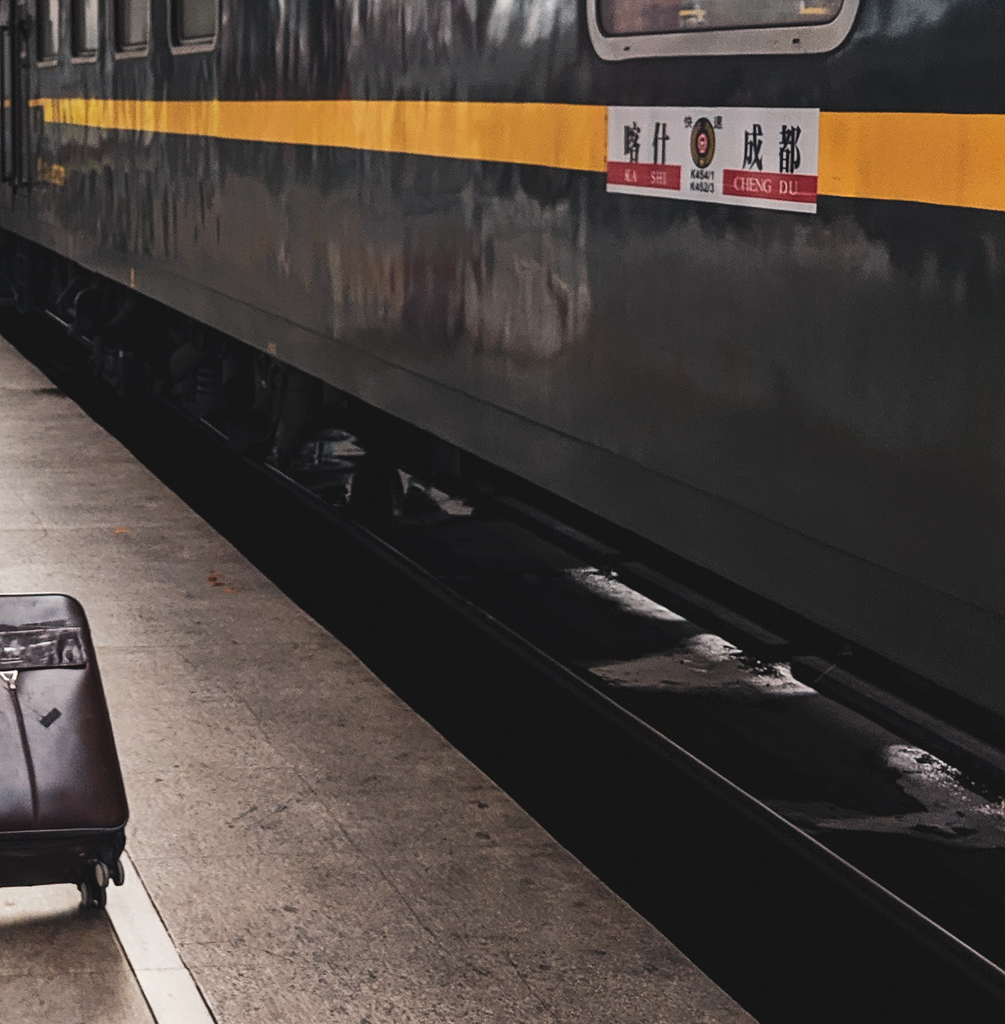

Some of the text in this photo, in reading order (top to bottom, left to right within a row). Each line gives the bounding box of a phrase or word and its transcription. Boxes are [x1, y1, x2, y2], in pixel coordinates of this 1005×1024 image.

[623, 121, 670, 164] 喀什
[742, 123, 802, 173] 成都
[733, 178, 799, 195] CHENG DU
